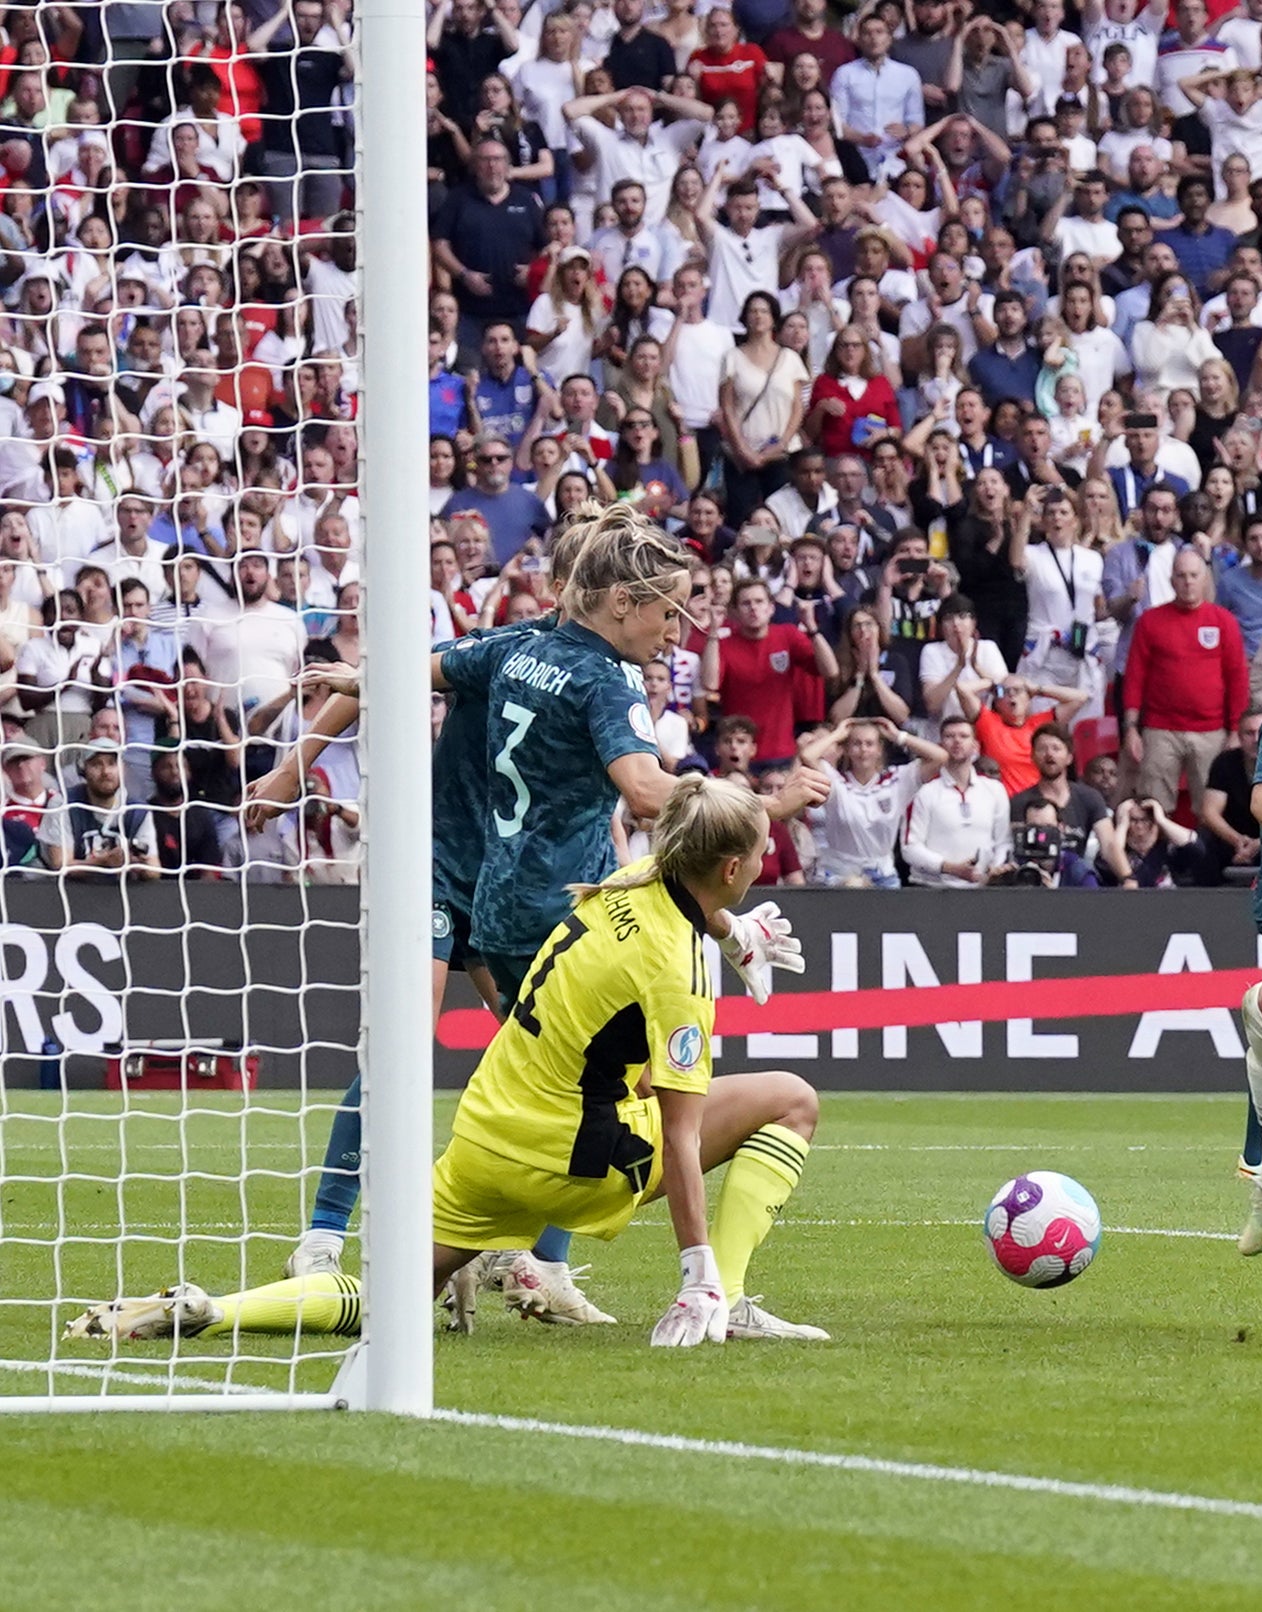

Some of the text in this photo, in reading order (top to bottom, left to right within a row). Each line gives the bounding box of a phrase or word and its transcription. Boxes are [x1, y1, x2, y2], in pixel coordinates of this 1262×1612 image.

[493, 701, 537, 838] 3
[513, 913, 590, 1039] 1
[604, 888, 640, 942] OHMS
